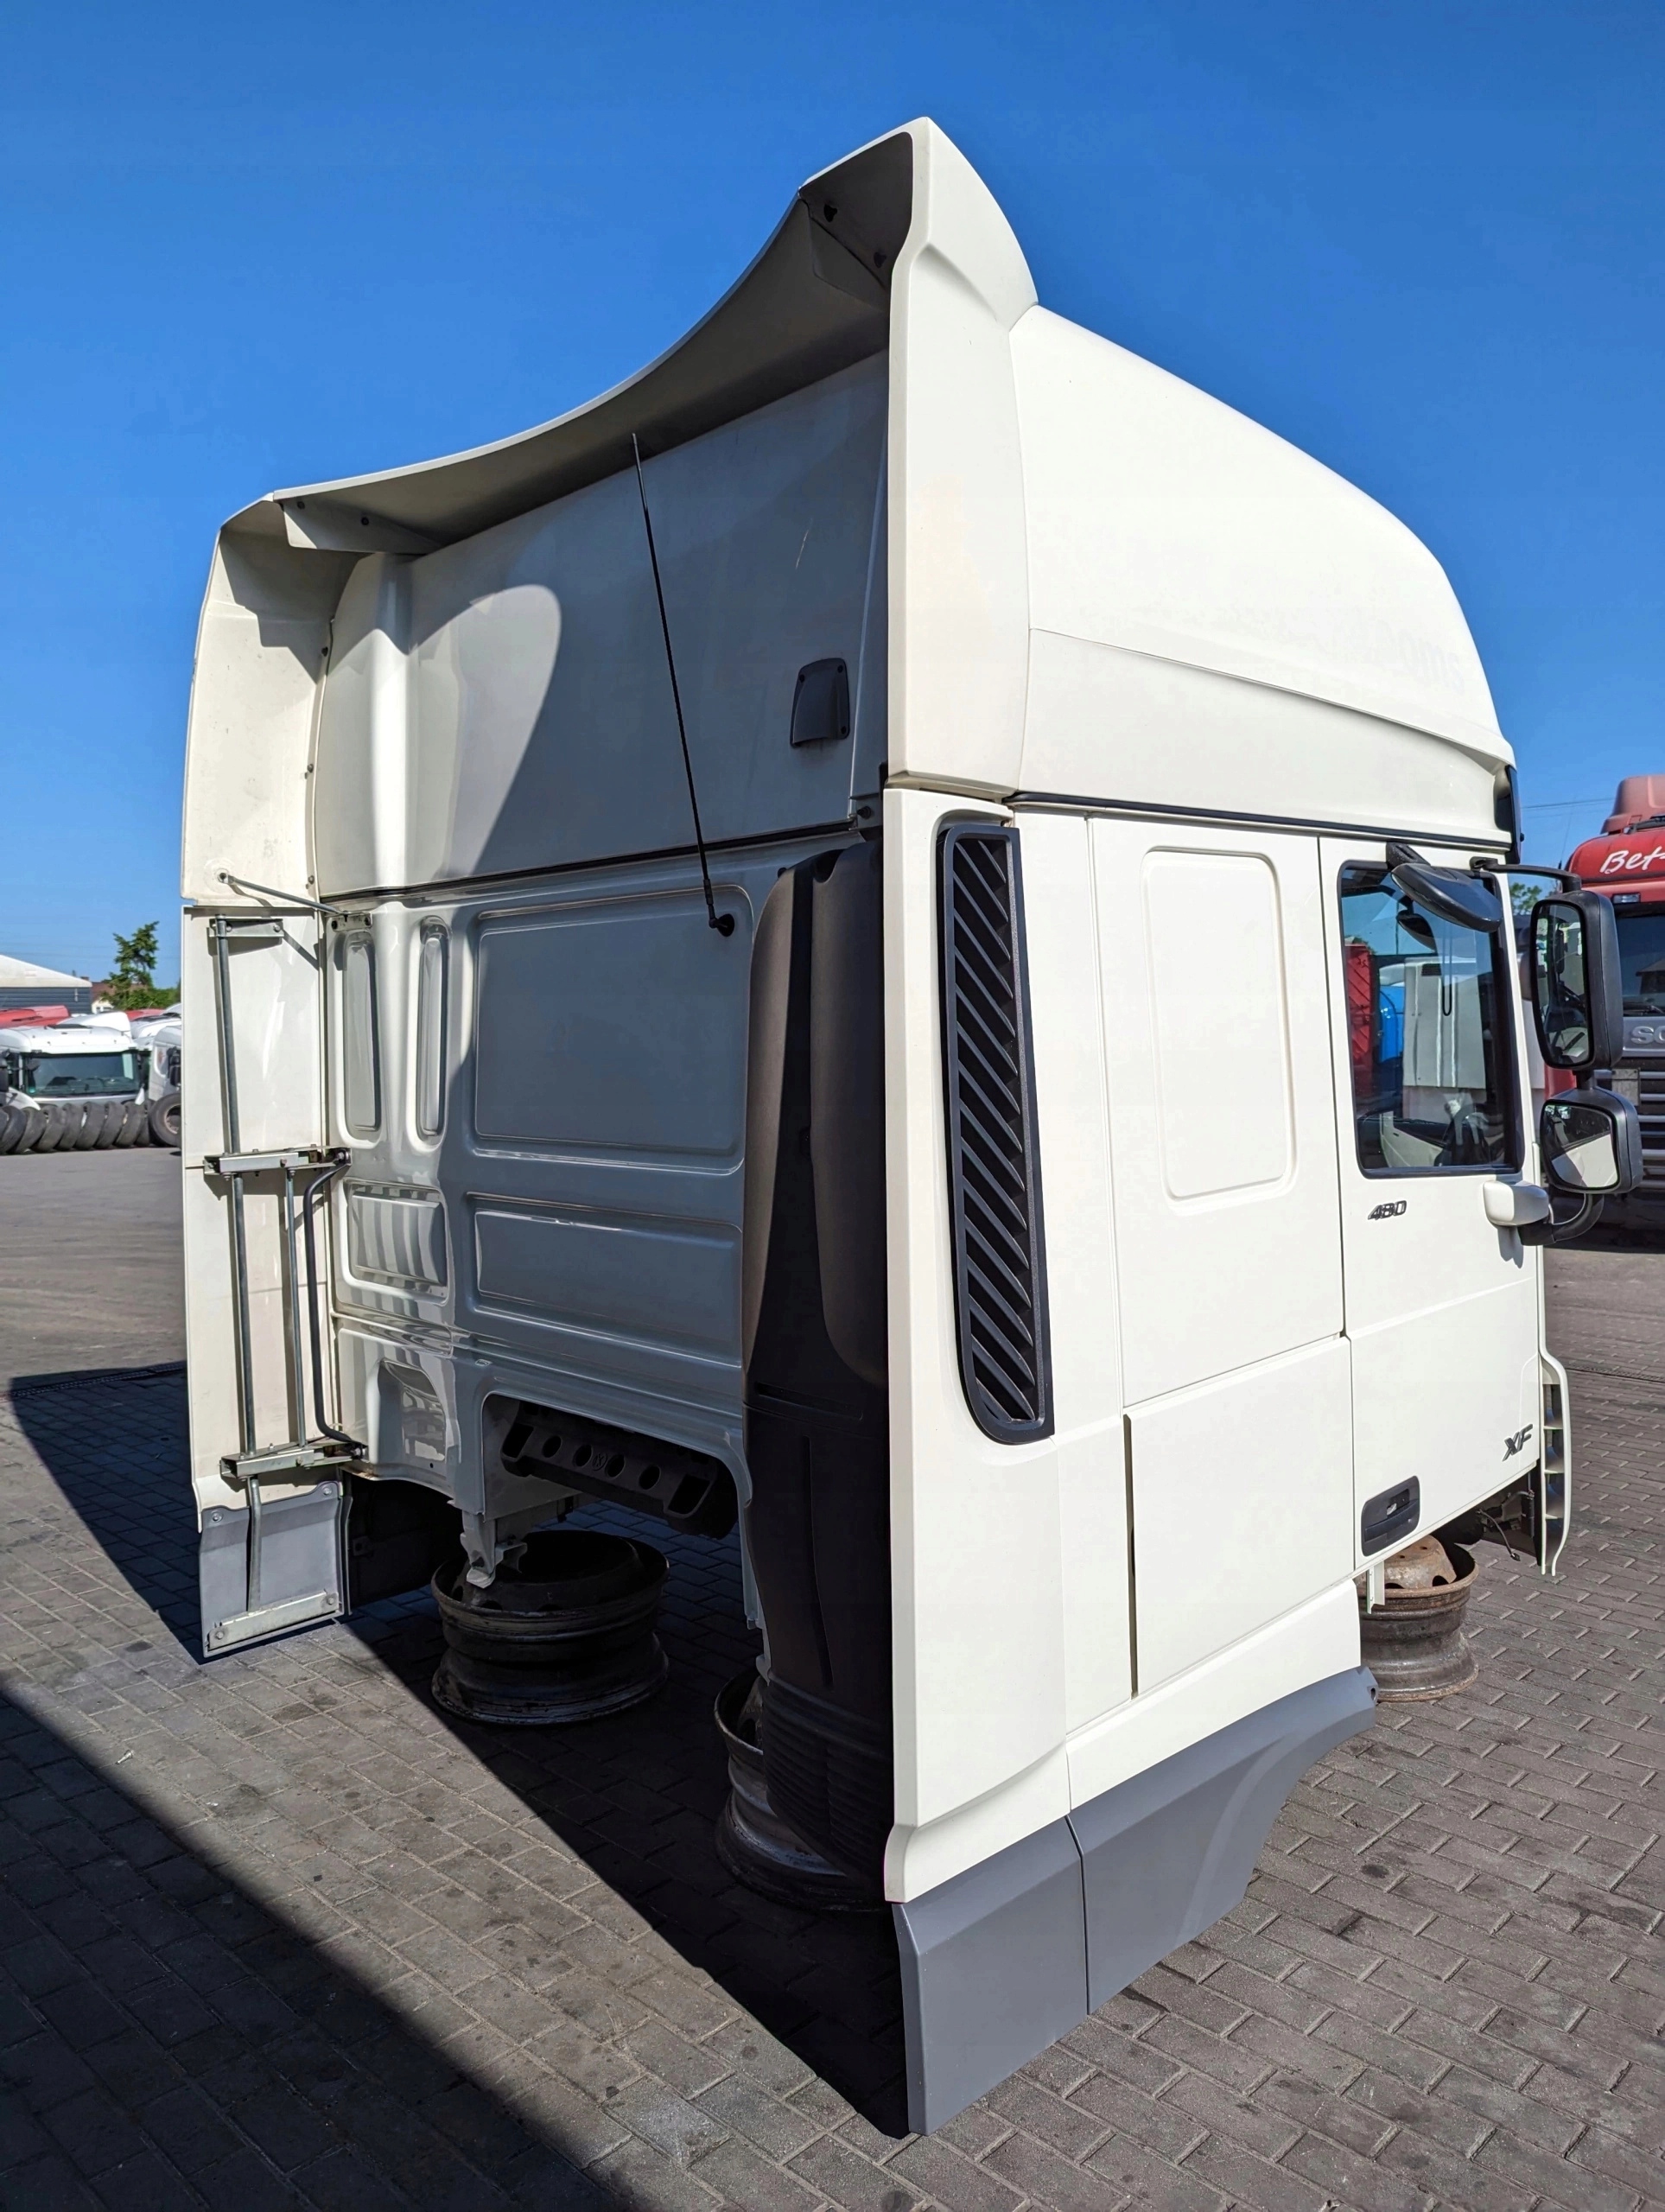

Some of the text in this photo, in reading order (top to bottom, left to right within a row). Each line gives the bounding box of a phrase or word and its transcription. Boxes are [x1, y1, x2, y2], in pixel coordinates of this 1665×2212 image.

[1599, 846, 1665, 874] Bet
[1367, 1199, 1408, 1221] 480
[1502, 1423, 1534, 1462] XF
